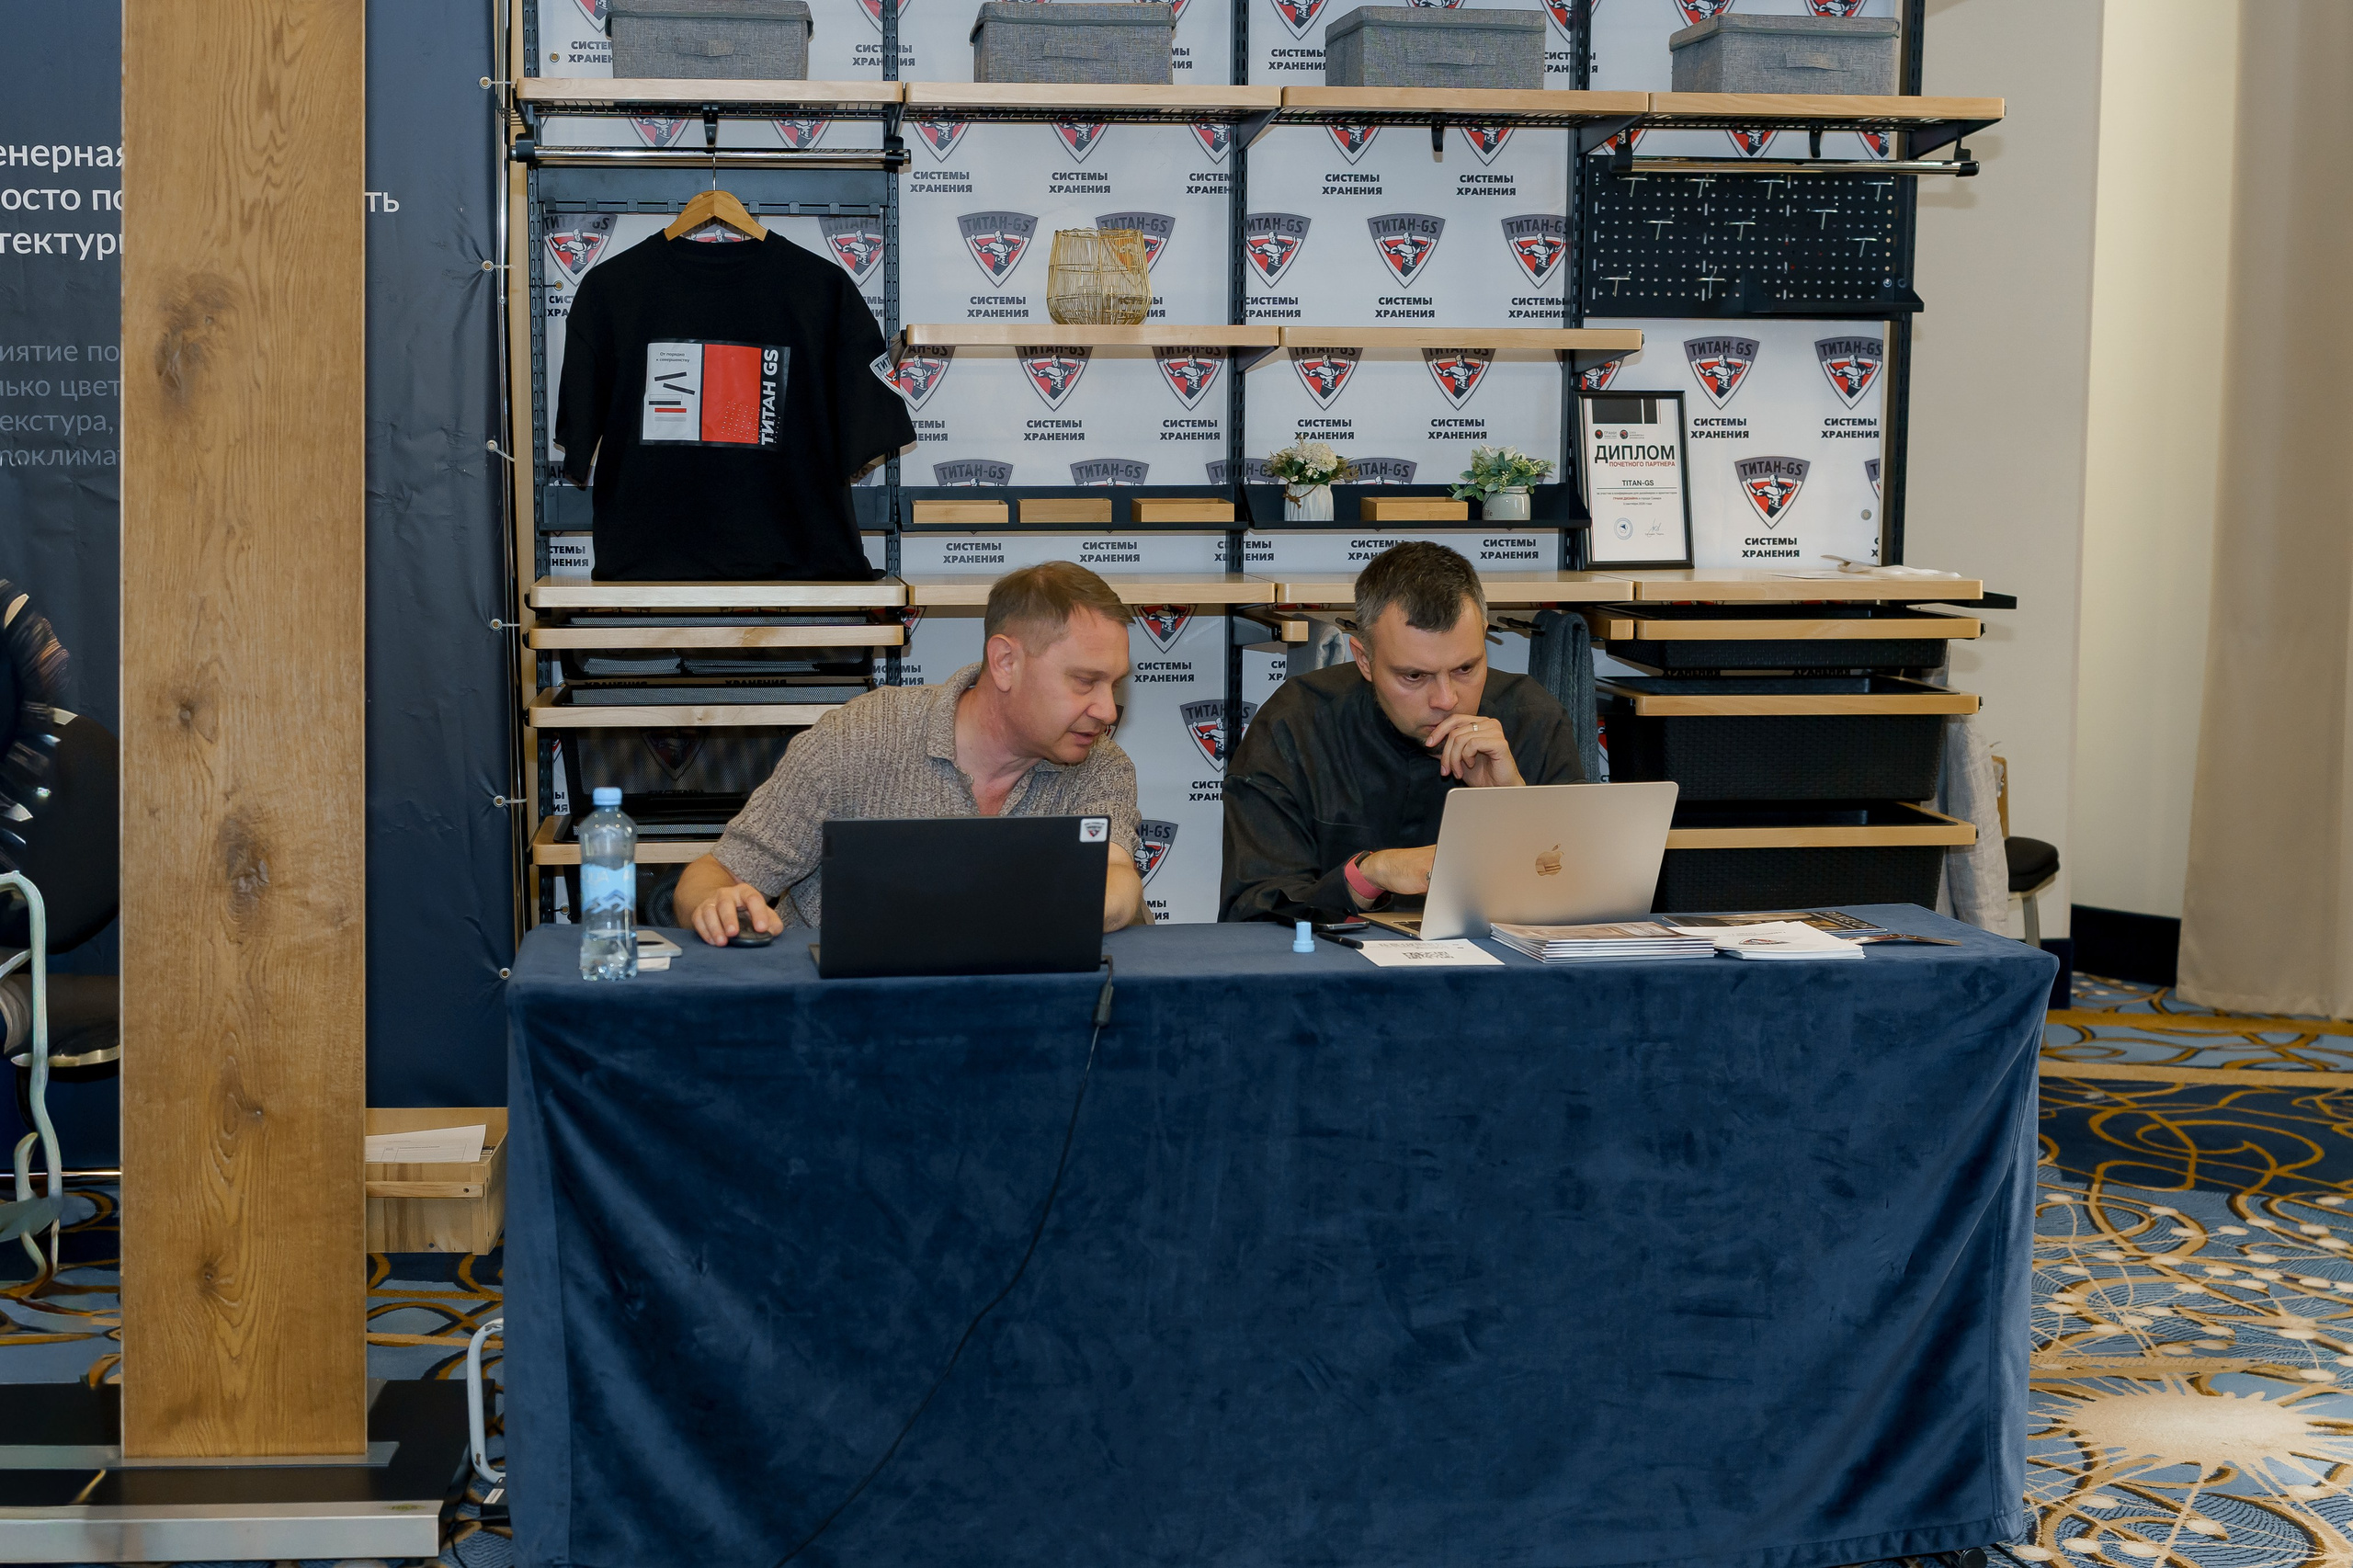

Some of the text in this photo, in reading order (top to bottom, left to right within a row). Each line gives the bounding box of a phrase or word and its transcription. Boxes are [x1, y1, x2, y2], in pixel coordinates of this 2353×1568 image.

[852, 58, 915, 66] ХРАНИЯ
[913, 171, 971, 181] СИСТЕМЫ
[1051, 172, 1108, 181] СИСТЕМЫ
[1324, 174, 1381, 183] СИСТЕМЫ
[1459, 175, 1514, 184] СИСТЕМЫ
[910, 185, 973, 194] ХРАНЕНИЯ
[1049, 185, 1111, 194] ХРАНЕНИЯ
[1322, 187, 1382, 196] ХРАНЕНИЯ
[1456, 187, 1517, 196] ХРАНЕНИЯ
[963, 215, 1031, 233] ТИТАН-GS
[1246, 217, 1304, 234] ИТАН-GS
[1373, 218, 1438, 234] ТИТАН-GS
[970, 296, 1027, 305] СИСТЕМЫ
[1378, 297, 1433, 306] СИСТЕМЫ
[967, 309, 1029, 318] ХРАНЕНИЯ
[1375, 310, 1436, 318] ХРАНЕНИЯ
[1689, 340, 1753, 357] ТИТАН-GS
[761, 349, 779, 446] ТИТАН GS
[1026, 419, 1083, 428] СИСТЕМЫ
[1162, 419, 1218, 428] СИСТЕМЫ
[1297, 418, 1352, 427] СИСТЕМЫ
[1430, 418, 1485, 426] СИСТЕМЫ
[1693, 417, 1747, 426] СИСТЕМЫ
[1824, 417, 1878, 426] СИСТЕМЫ
[1023, 432, 1086, 441] ХРАНЕНИЯ
[1159, 432, 1221, 440] ХРАНЕНИЯ
[1294, 431, 1355, 440] ХРАНЕНИЯ
[1427, 431, 1488, 439] ХРАНЕНИЯ
[1690, 430, 1750, 438] ХРАНЕНИЯ
[1821, 430, 1880, 438] ХРАНЕНИЯ
[1595, 445, 1676, 463] ДИПЛОМ
[938, 462, 1006, 480] ТИТАН-GS
[1075, 462, 1142, 479] ТИТАН-GS
[1740, 460, 1803, 476] ТИТАН-GS
[1082, 541, 1138, 551] СИСТЕМЫ
[1483, 539, 1537, 548] СИСТЕМЫ
[1745, 537, 1798, 546] СИСТЕМЫ
[946, 542, 1002, 551] СИСТЕМЫ
[1079, 553, 1141, 562] ХРАНЕНИЯ
[1480, 551, 1540, 560] ХРАНЕНИЯ
[1742, 549, 1801, 558] ХРАНЕНИЯ
[943, 554, 1005, 563] ХРАНЕНИЯ
[1137, 662, 1192, 671] СИСТЕМЫ
[1134, 674, 1195, 683] ХРАНЕНИЯ
